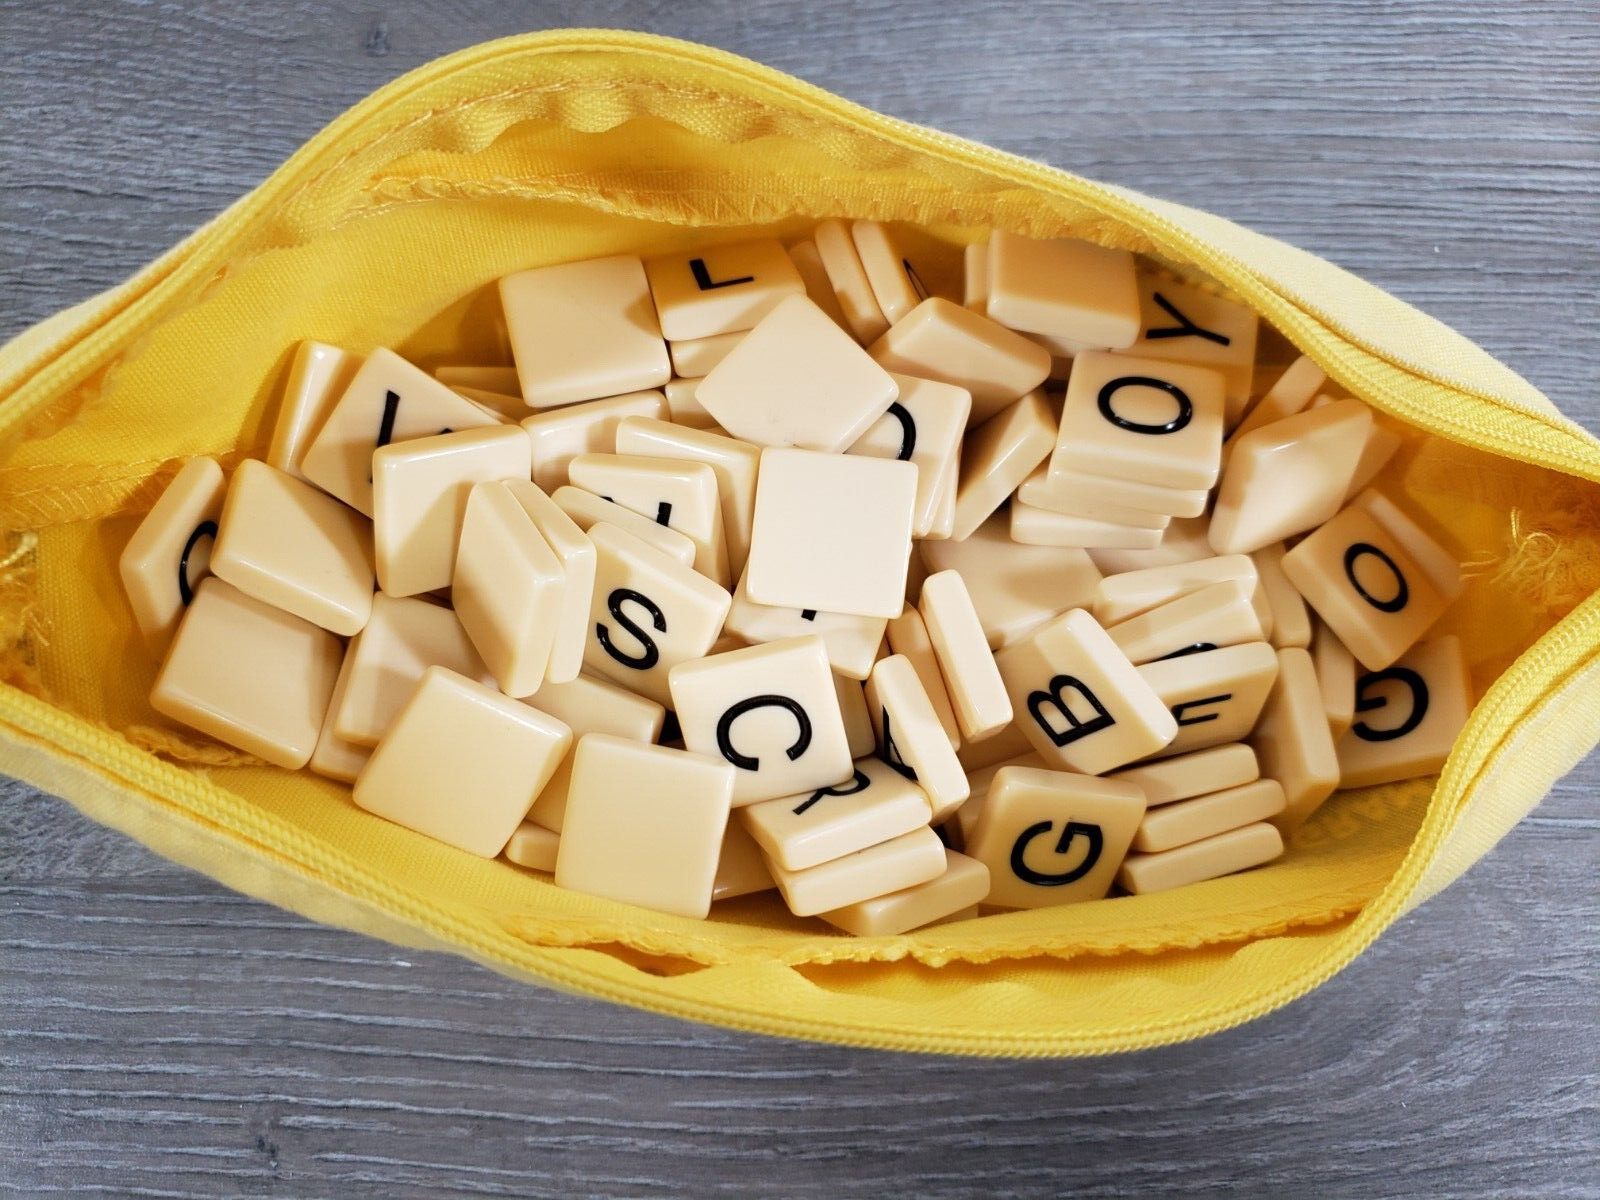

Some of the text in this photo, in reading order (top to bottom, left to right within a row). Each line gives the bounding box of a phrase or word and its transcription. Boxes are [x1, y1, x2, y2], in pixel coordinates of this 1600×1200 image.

[688, 258, 755, 291] L
[1145, 291, 1231, 347] Y
[1098, 376, 1193, 435] O
[1343, 542, 1410, 613] O
[596, 588, 667, 671] S
[716, 694, 813, 772] C
[1027, 674, 1116, 747] B
[1352, 666, 1429, 742] G
[1010, 820, 1104, 887] G
